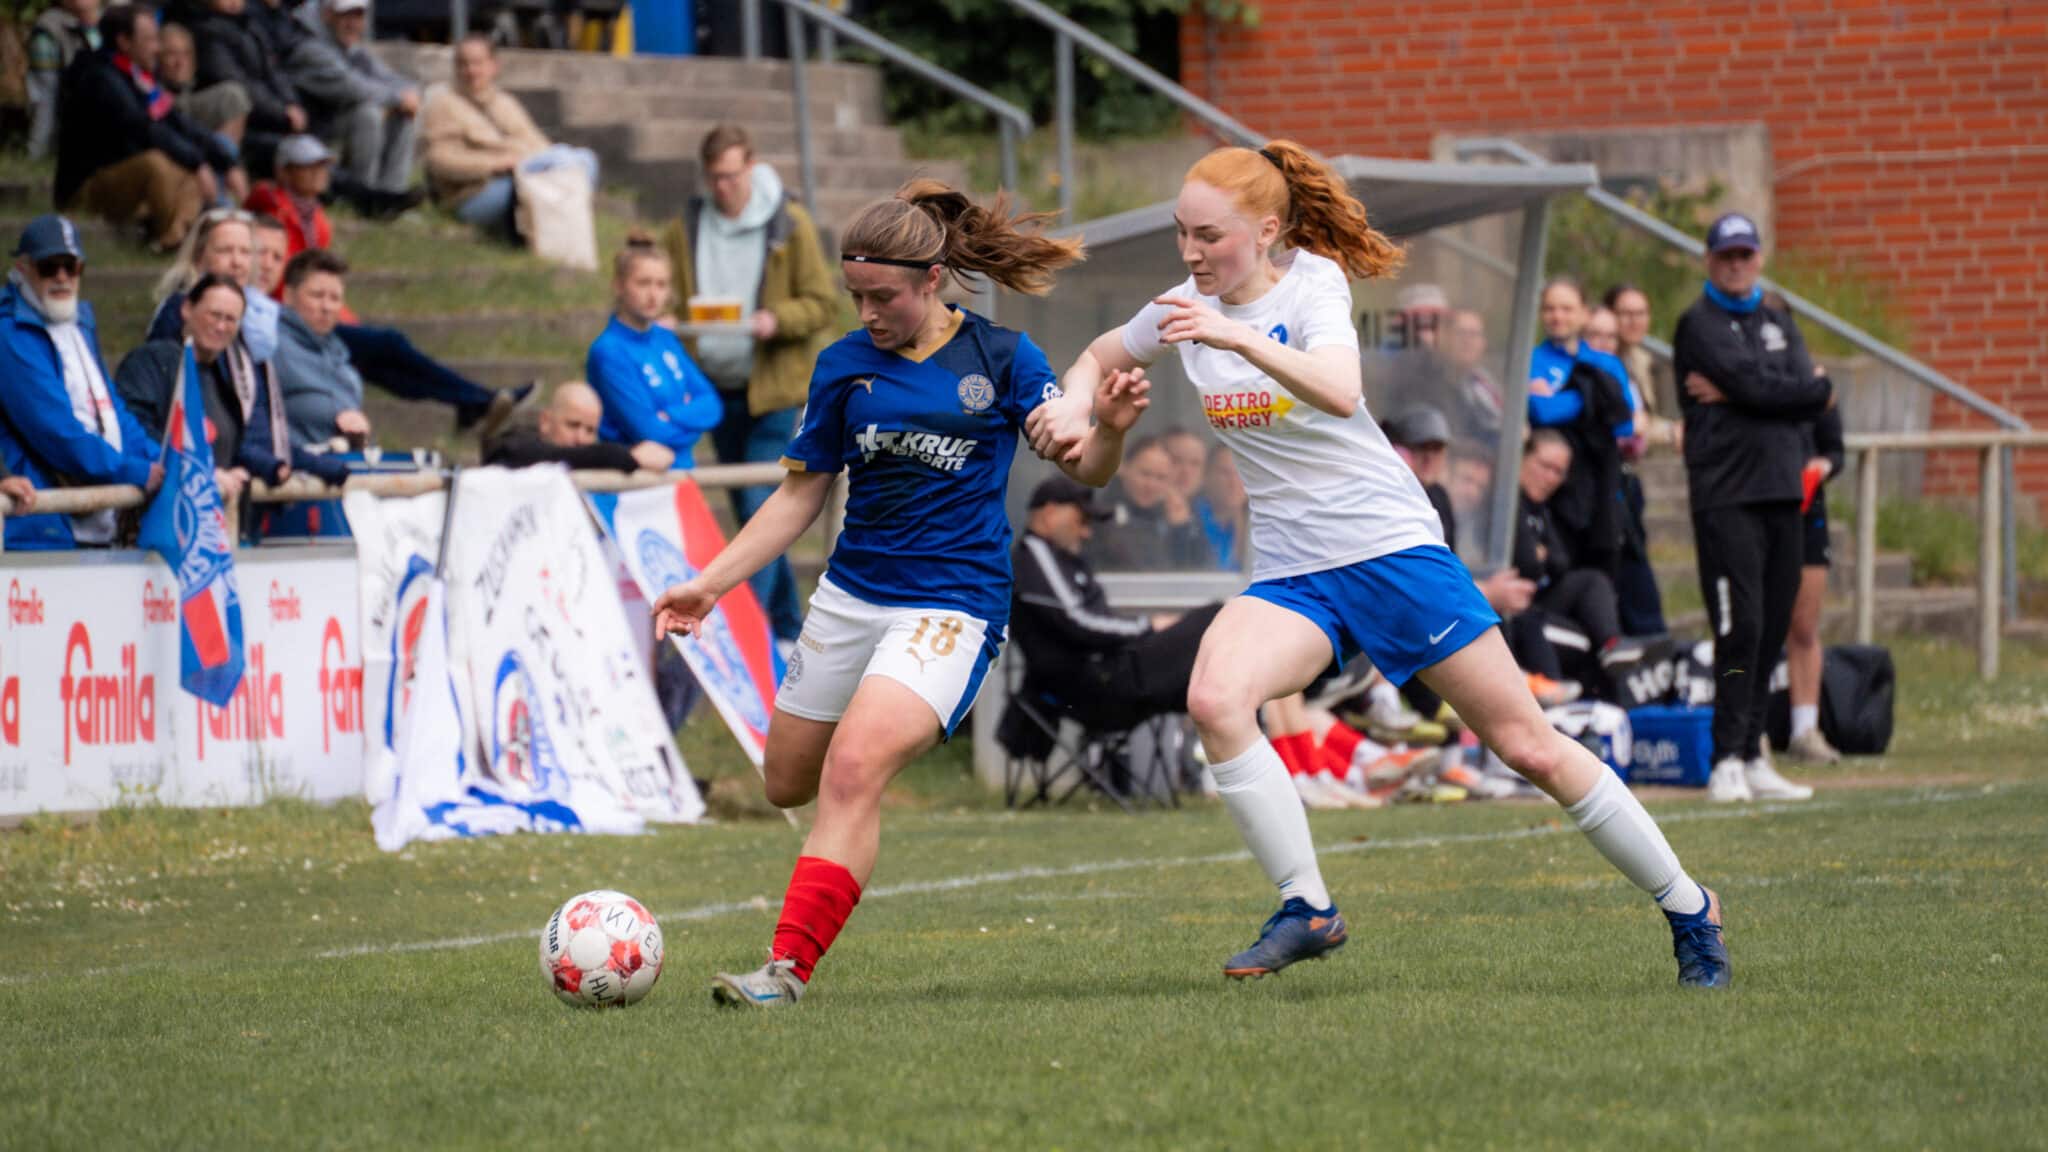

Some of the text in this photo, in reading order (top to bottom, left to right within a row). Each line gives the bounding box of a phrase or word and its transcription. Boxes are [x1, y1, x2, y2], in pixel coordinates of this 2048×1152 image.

[1204, 391, 1271, 412] DEXTRO
[899, 432, 978, 457] KRUG
[8, 577, 44, 632] famila
[143, 579, 175, 630] famila
[269, 579, 302, 628] famila
[909, 616, 964, 657] 18
[61, 621, 155, 766] famila
